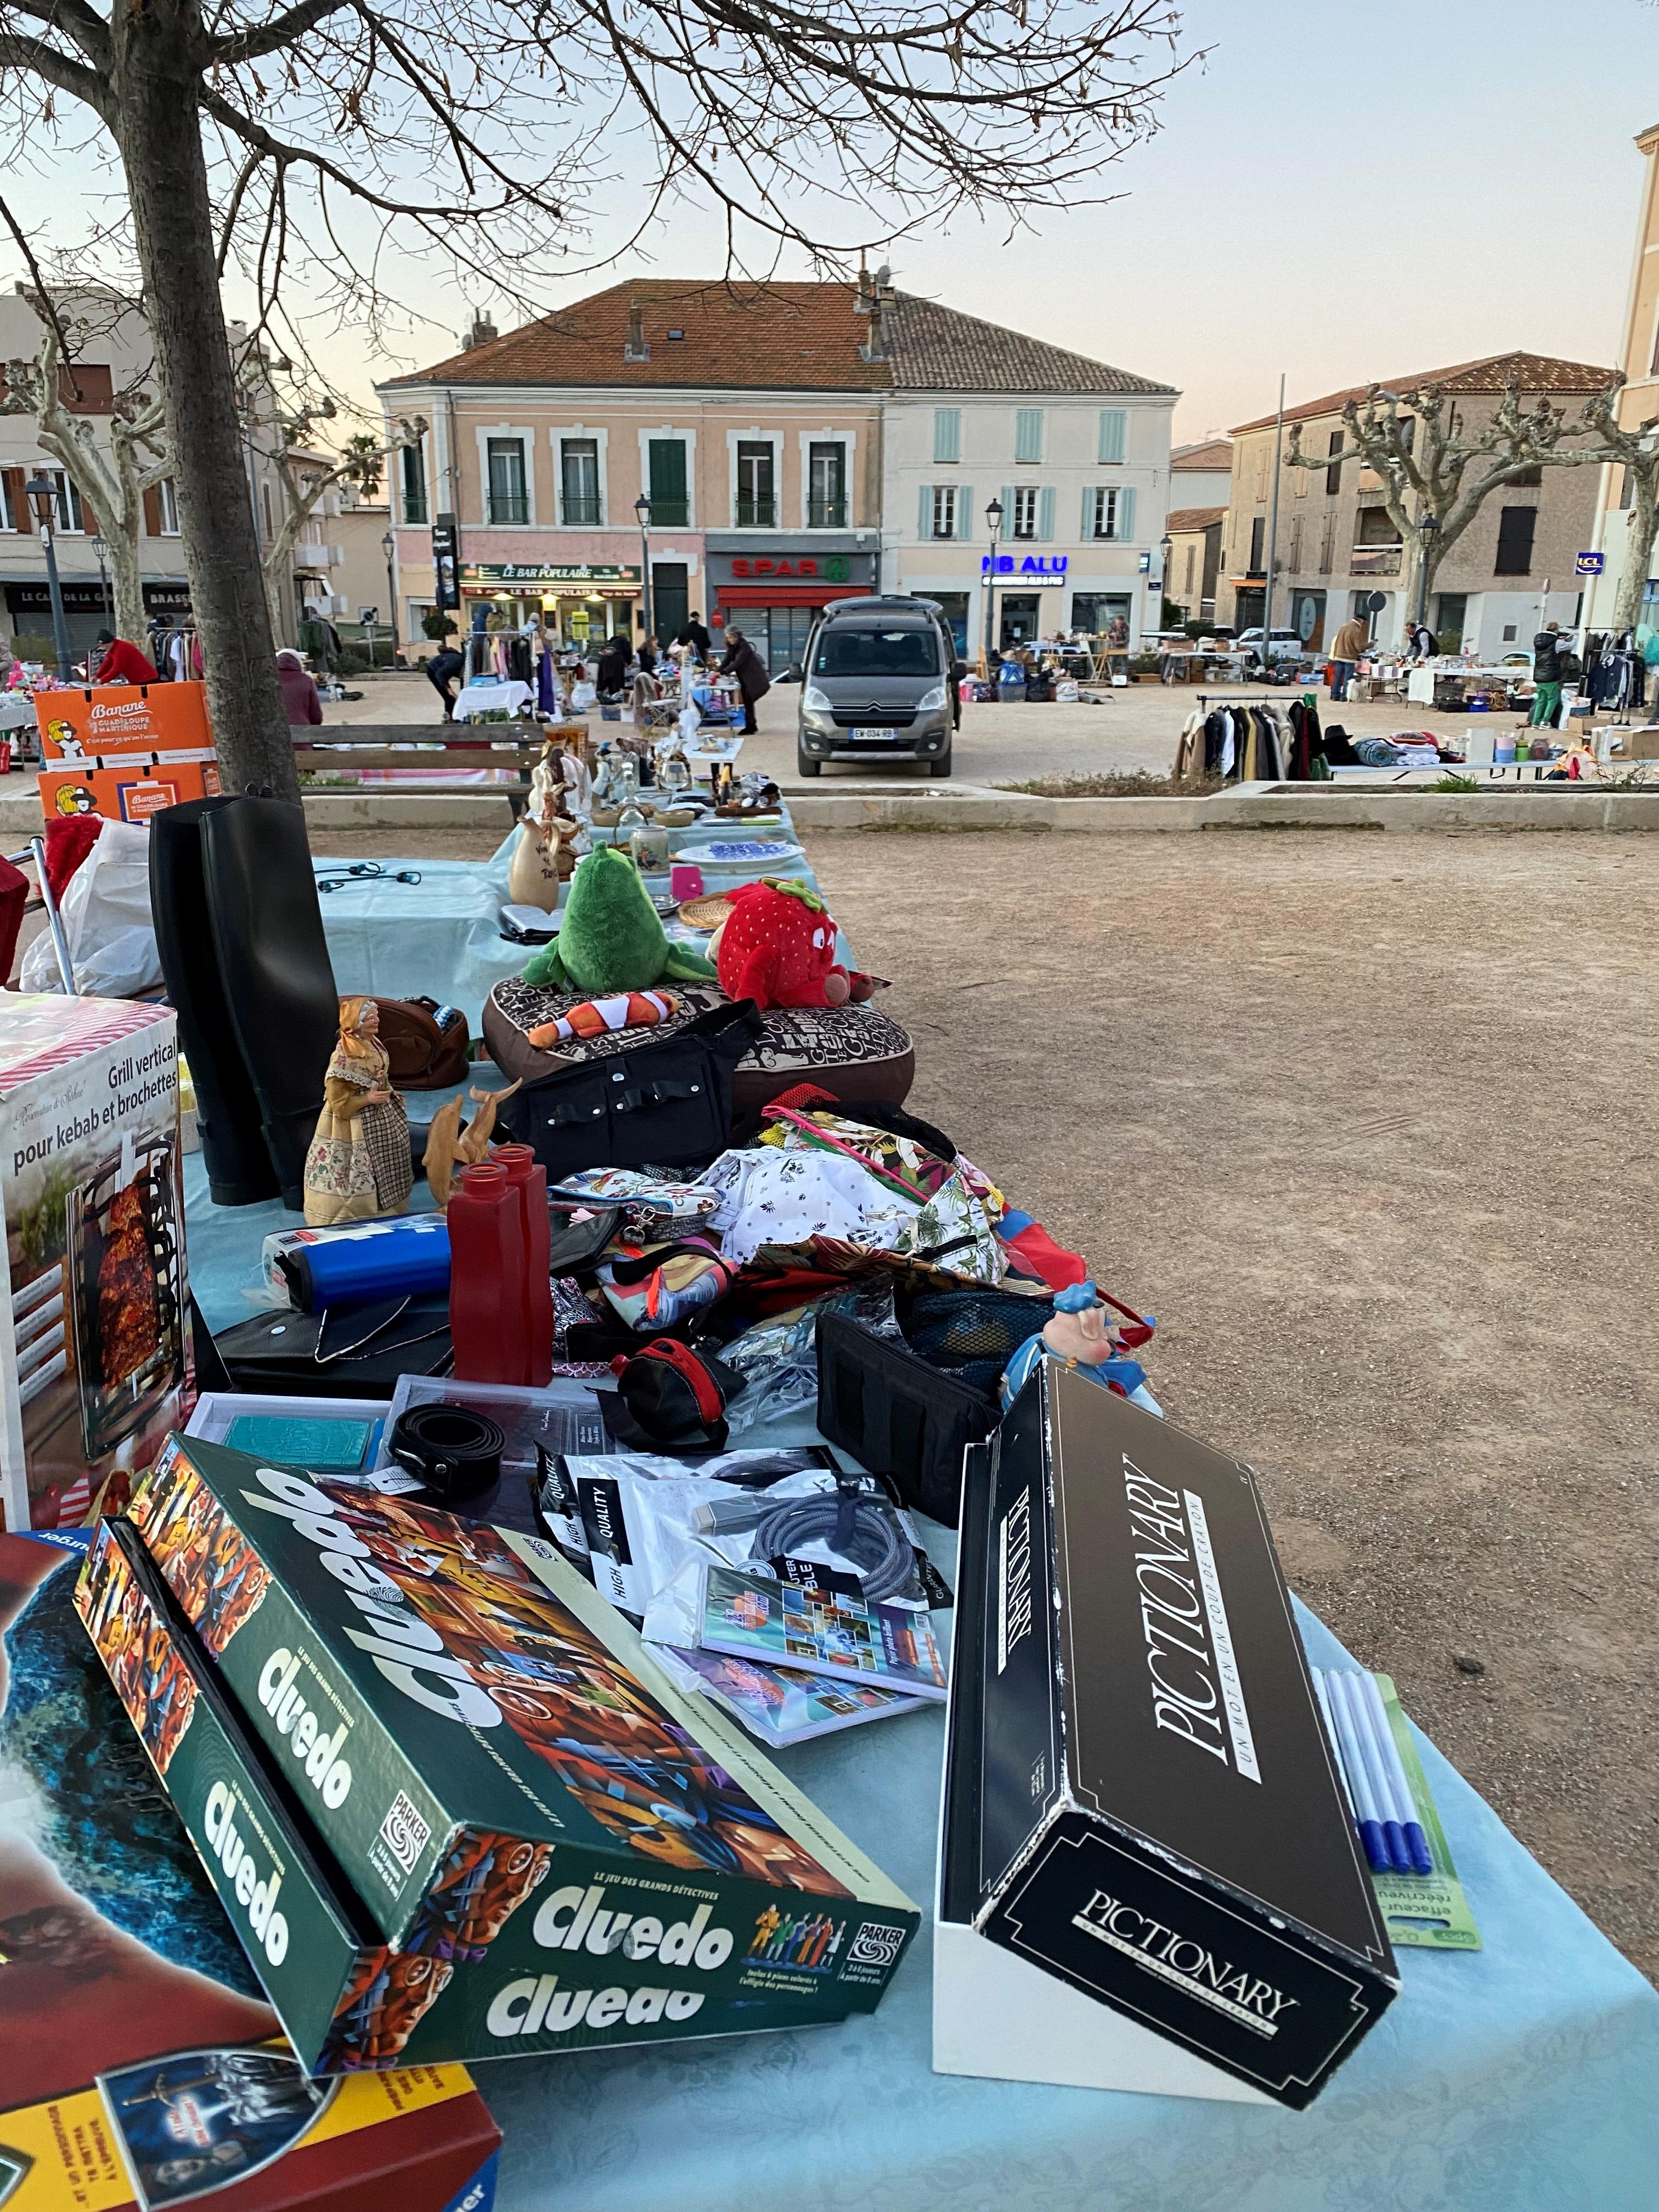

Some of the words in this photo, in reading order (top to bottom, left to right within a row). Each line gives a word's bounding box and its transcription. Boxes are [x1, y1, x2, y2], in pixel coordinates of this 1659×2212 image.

[503, 568, 516, 577] LE
[516, 568, 538, 578] BAR
[538, 568, 592, 578] POPULAIRE
[731, 558, 817, 577] SPAR
[981, 555, 1014, 573] NB
[1020, 555, 1068, 573] ALU
[1578, 557, 1601, 566] LCL
[21, 591, 34, 602] LE
[64, 593, 77, 602] DE
[78, 592, 91, 602] LA
[91, 701, 148, 719] Banane
[98, 716, 150, 726] GUADELOUPE
[98, 724, 149, 733] MARTINIQUE
[855, 729, 893, 738] EW-034-RB
[131, 793, 167, 805] Banane
[108, 1057, 133, 1089] Grill
[136, 1036, 176, 1075] vertical
[14, 1135, 53, 1177] pour
[57, 1108, 100, 1150] kebab
[103, 1102, 115, 1125] et
[117, 1070, 177, 1118] brochettes
[544, 1453, 565, 1499] QUALITY
[593, 1487, 613, 1539] QUALITY
[1190, 1502, 1209, 1554] CRAYON
[564, 1520, 584, 1546] HIGH
[609, 1566, 627, 1599] HIGH
[1008, 1484, 1031, 1655] PICTIONARY
[1204, 1561, 1214, 1578] DE
[239, 1468, 503, 1728] Cluedo
[1122, 1452, 1229, 1767] PICTIONARY
[1209, 1585, 1223, 1624] COUP
[1220, 1635, 1232, 1655] UN
[1224, 1664, 1233, 1684] EN
[1233, 1691, 1246, 1730] MOT
[257, 1647, 352, 1810] Cluedo
[1240, 1737, 1252, 1764] UN
[487, 1751, 523, 1782] GRANDS
[392, 1794, 430, 1848] PARKER
[204, 1781, 289, 1967] Cluedo
[593, 1871, 603, 1881] LE
[603, 1873, 620, 1884] JEU
[621, 1875, 639, 1887] DES
[638, 1878, 673, 1893] GRANDS
[672, 1883, 720, 1901] DÉTECTIVES
[1381, 1903, 1452, 1916] effaceur-
[532, 1885, 735, 1971] Cluedo
[857, 1925, 904, 1945] PARKER
[1079, 1888, 1297, 2021] PICTIONARY
[1082, 1922, 1098, 1935] UN
[1103, 1934, 1127, 1951] MOT
[1129, 1950, 1144, 1960] EN
[1148, 1960, 1164, 1971] UN
[1169, 1971, 1200, 1990] COUP
[1204, 1991, 1218, 2001] DE
[1223, 2000, 1269, 2029] CRAYON
